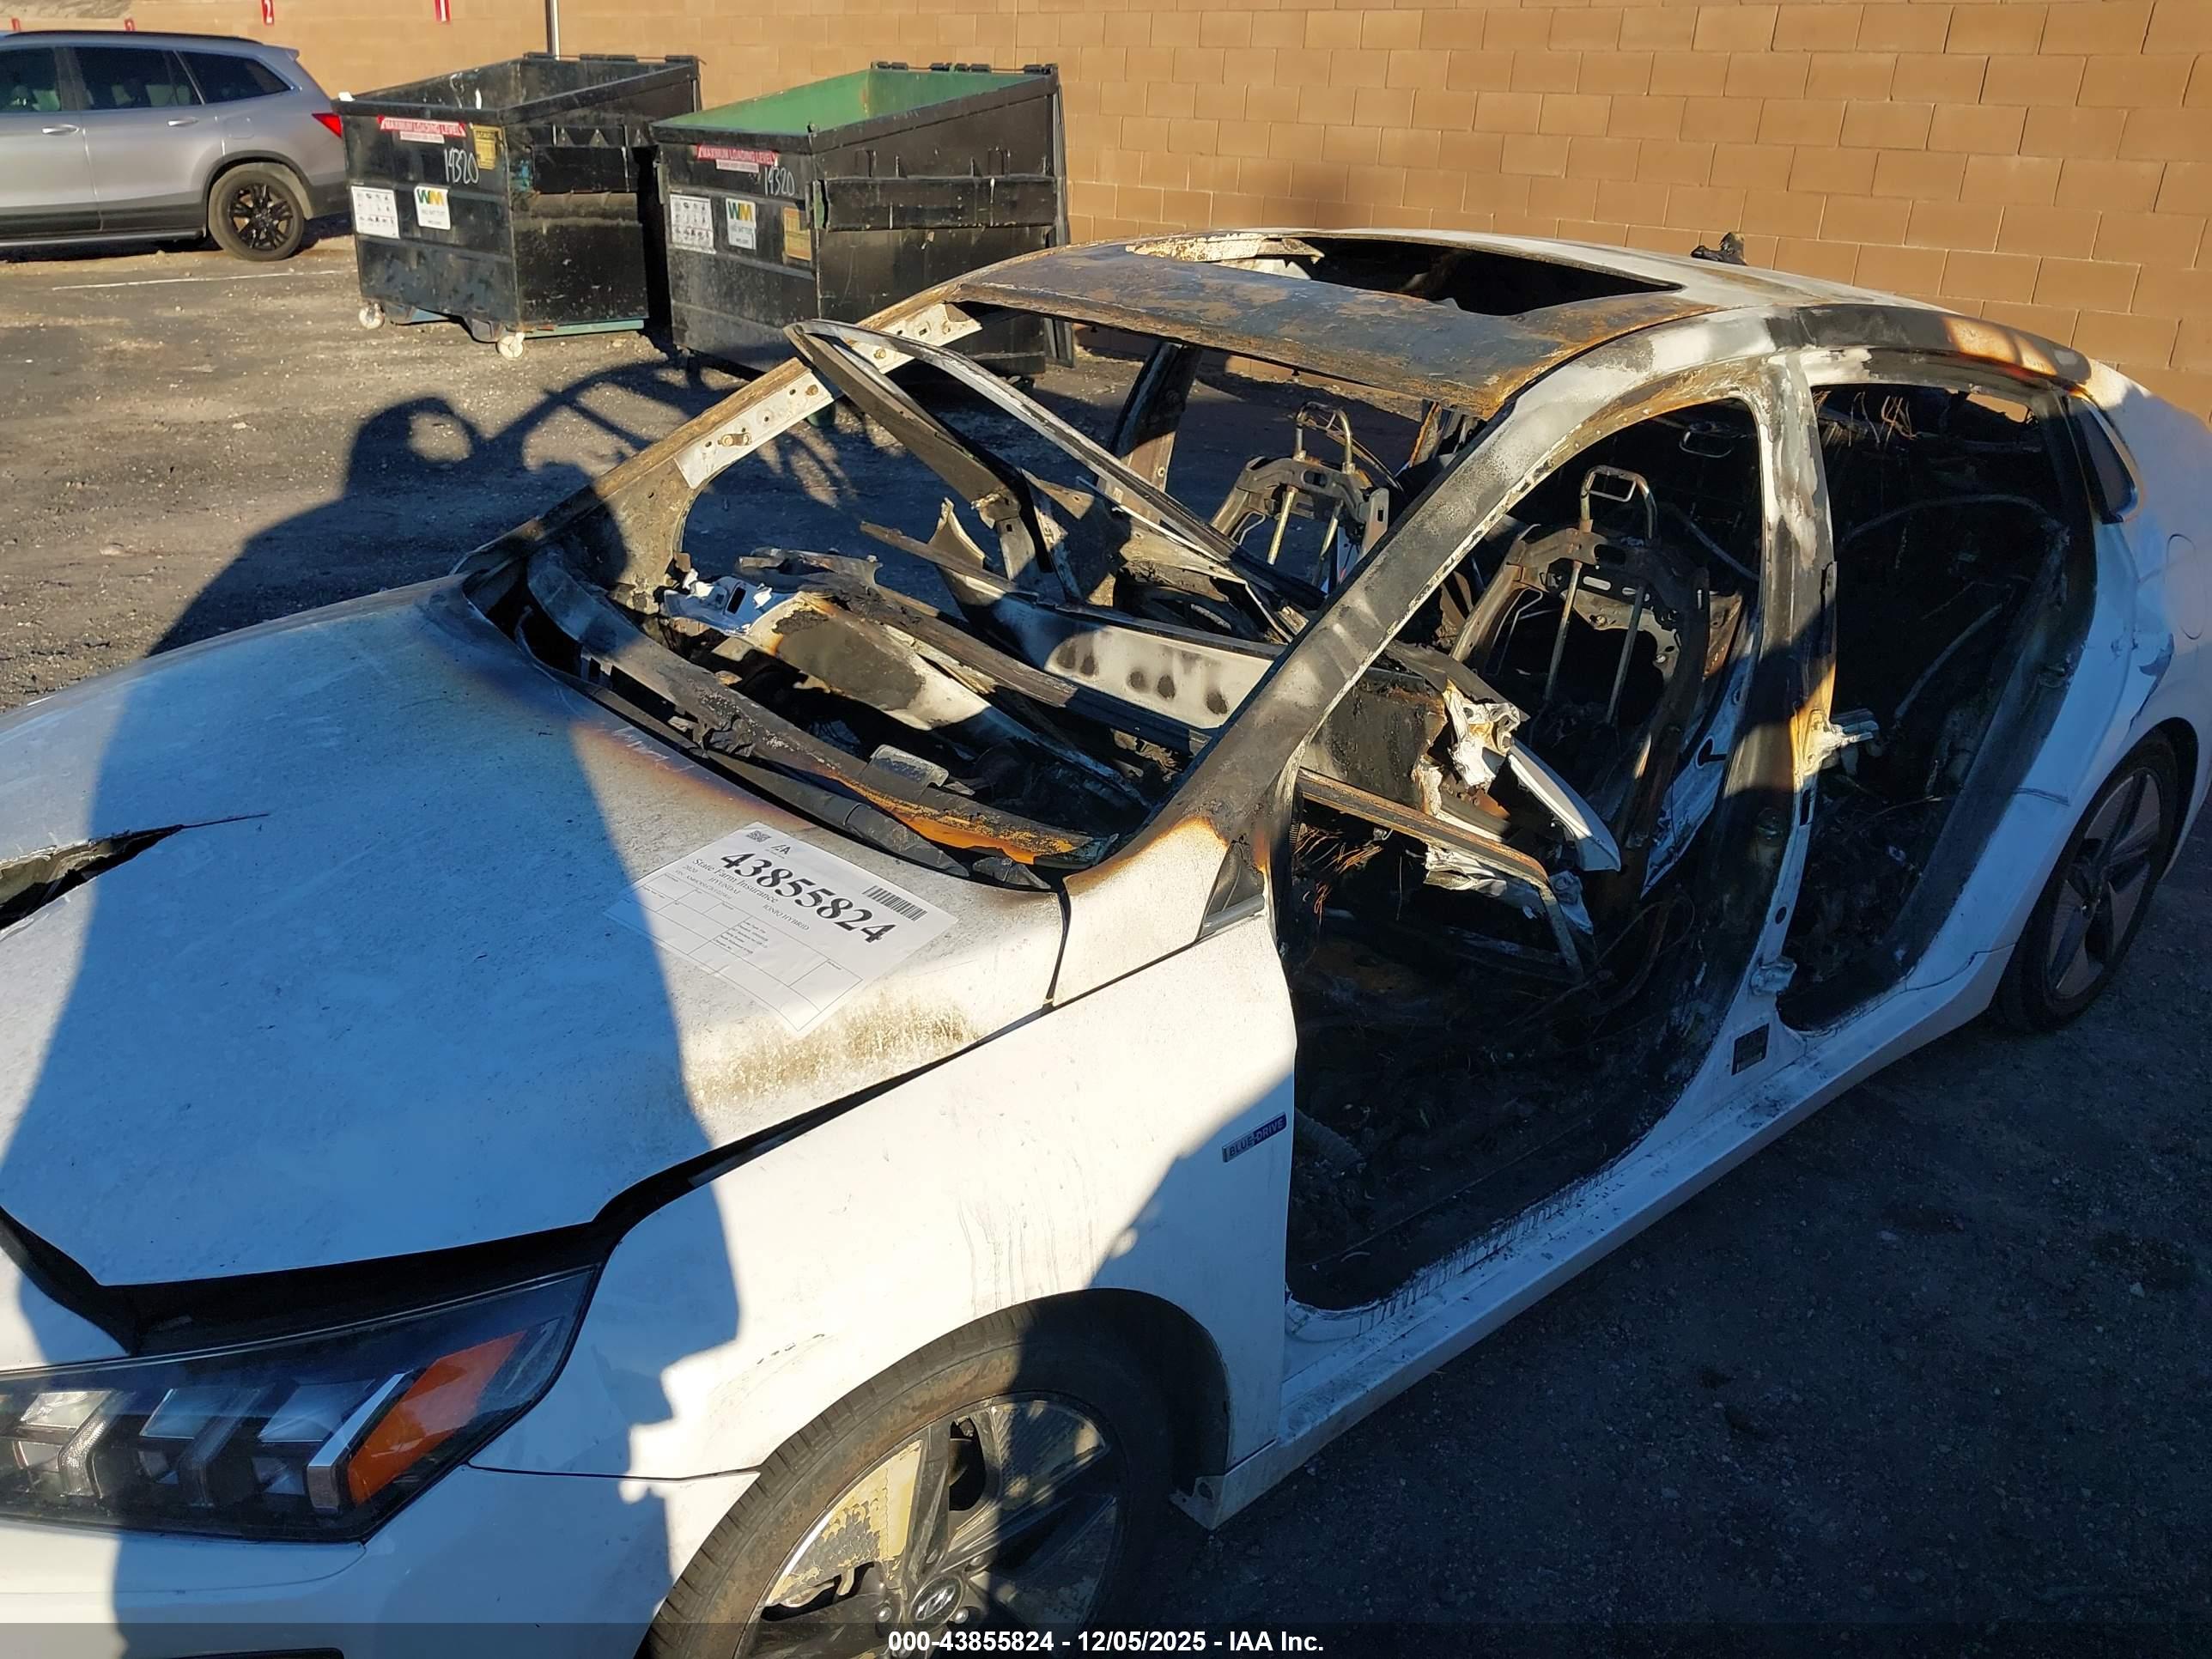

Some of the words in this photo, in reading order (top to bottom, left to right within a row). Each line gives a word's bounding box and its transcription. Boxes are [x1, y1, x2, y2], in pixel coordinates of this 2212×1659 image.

[384, 118, 412, 131] MAXIMUM
[414, 120, 441, 135] LOADING
[441, 124, 460, 136] LEVEL
[701, 147, 728, 160] MAXIMUM
[729, 149, 756, 162] LOADING
[756, 151, 774, 165] LEVEL
[416, 189, 444, 206] WM
[728, 201, 752, 222] WM
[692, 858, 715, 872] State
[714, 868, 738, 883] Farm
[737, 879, 779, 903] Insurance
[708, 876, 741, 896] HYUNDAI
[763, 903, 782, 920] IONIQ
[781, 913, 810, 931] HYBRID
[720, 853, 896, 943] 43855824
[1229, 1117, 1285, 1157] BLUE-DRIVE
